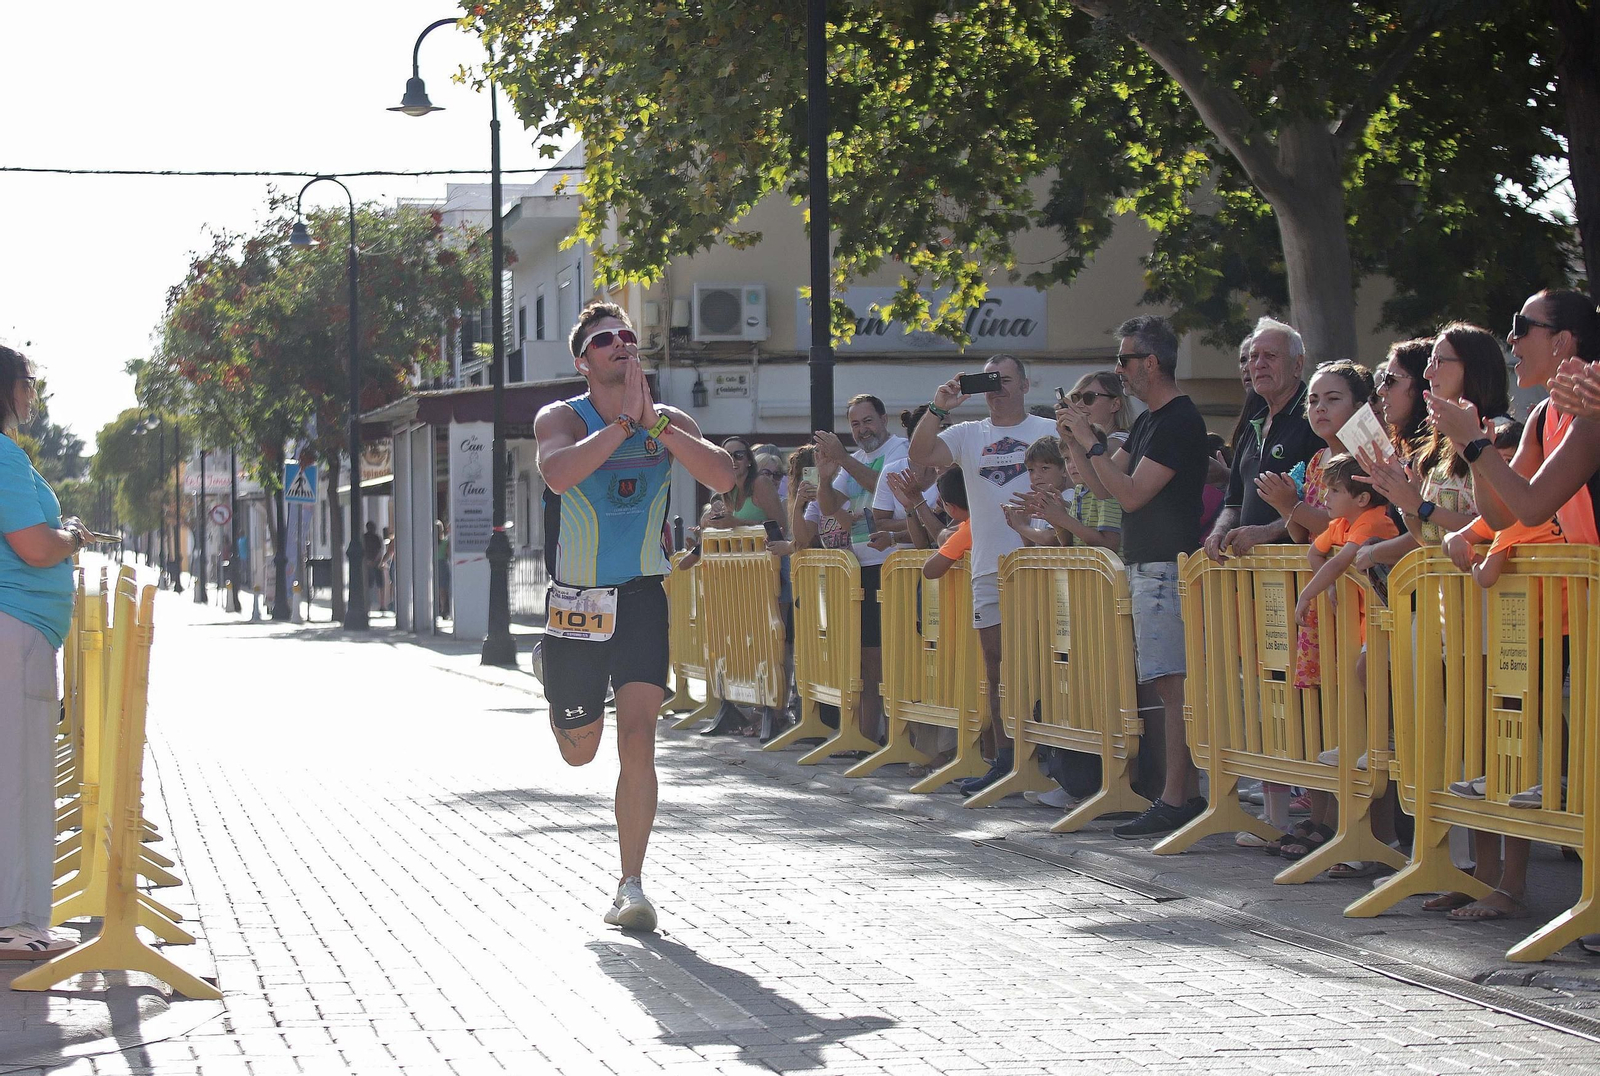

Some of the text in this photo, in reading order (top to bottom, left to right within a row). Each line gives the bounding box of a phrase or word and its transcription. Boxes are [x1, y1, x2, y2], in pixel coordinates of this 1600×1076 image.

[965, 297, 1038, 344] Tina
[460, 439, 486, 453] Can
[459, 481, 488, 498] Tina
[555, 610, 603, 629] 101
[1265, 640, 1288, 651] Los Barrios
[1499, 659, 1528, 671] Los Barrios
